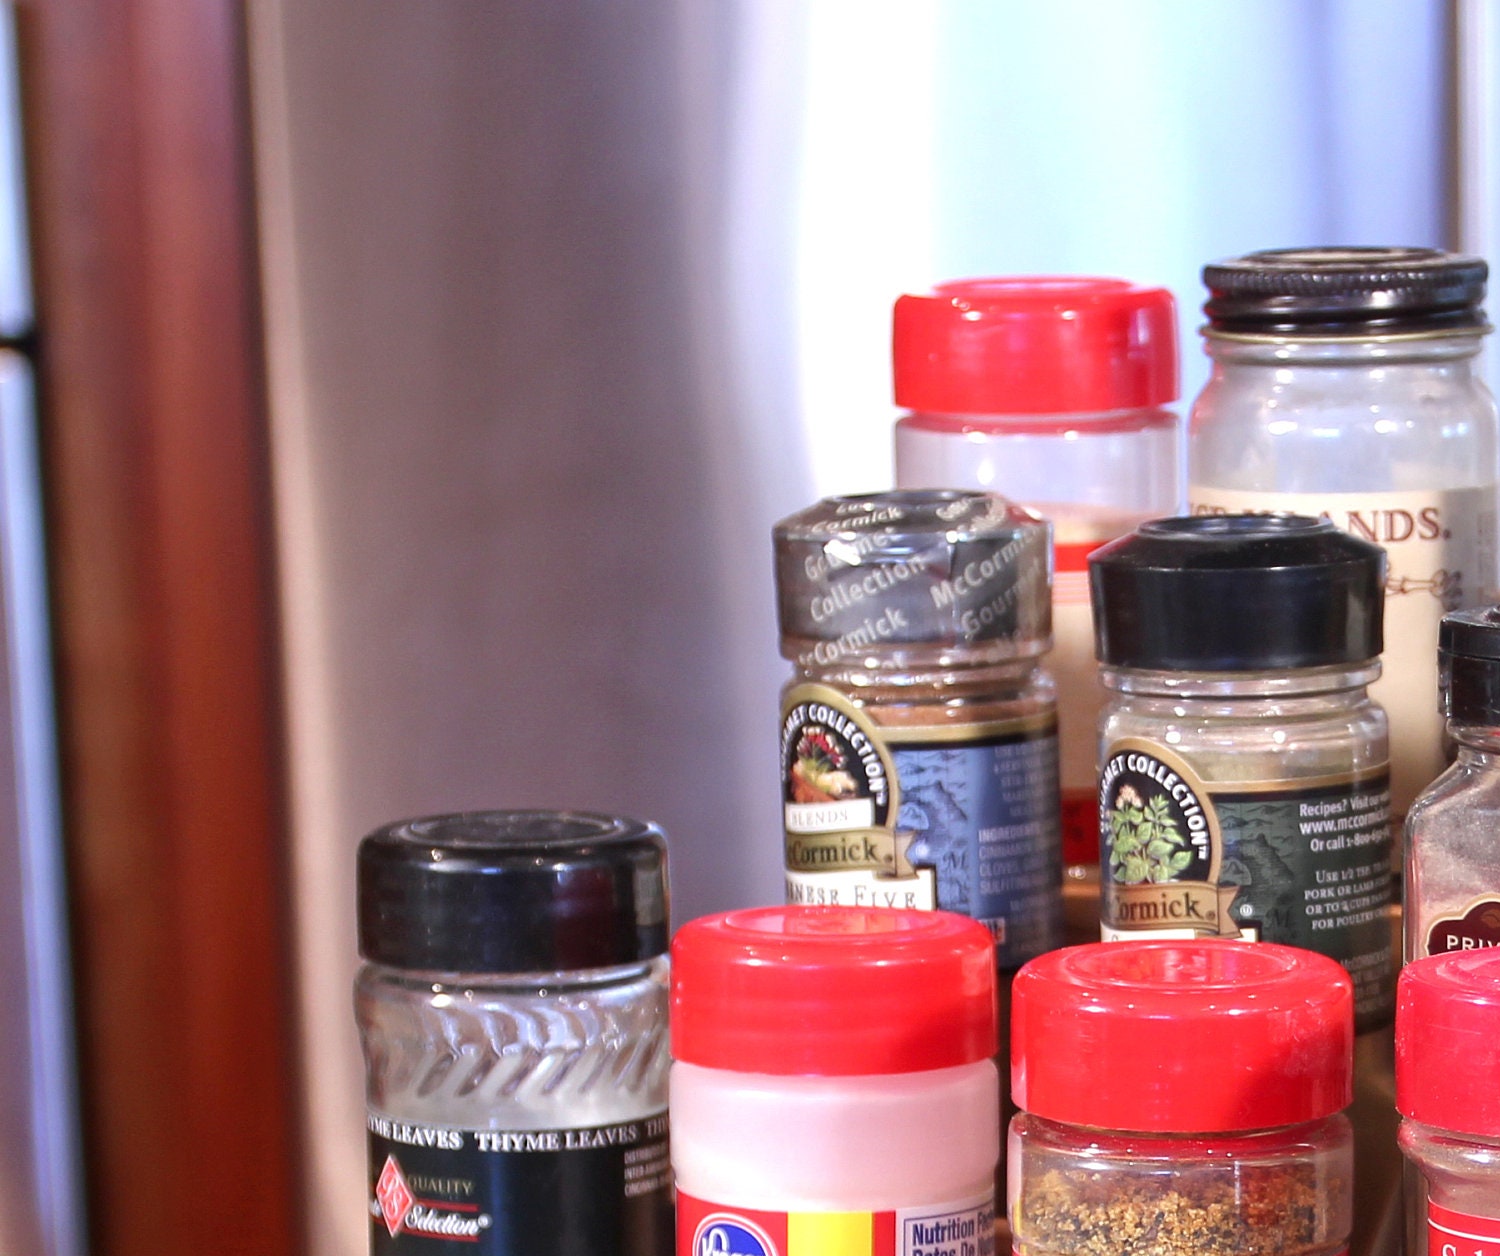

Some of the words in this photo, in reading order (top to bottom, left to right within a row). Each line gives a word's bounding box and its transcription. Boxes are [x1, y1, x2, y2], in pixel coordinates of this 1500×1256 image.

[791, 807, 848, 827] BLENDS
[1300, 798, 1347, 817] Recipes?
[1310, 838, 1324, 852] Or
[1326, 834, 1345, 850] call
[1304, 887, 1335, 901] PORK
[1337, 885, 1352, 897] OR
[1305, 904, 1322, 916] OR
[1324, 901, 1340, 914] TO
[1312, 918, 1335, 931] FOR
[392, 1121, 464, 1151] LEAVES
[474, 1131, 560, 1152] THYME
[564, 1124, 638, 1149] LEAVES
[407, 1174, 473, 1196] QUALITY
[912, 1215, 975, 1246] Nutrition
